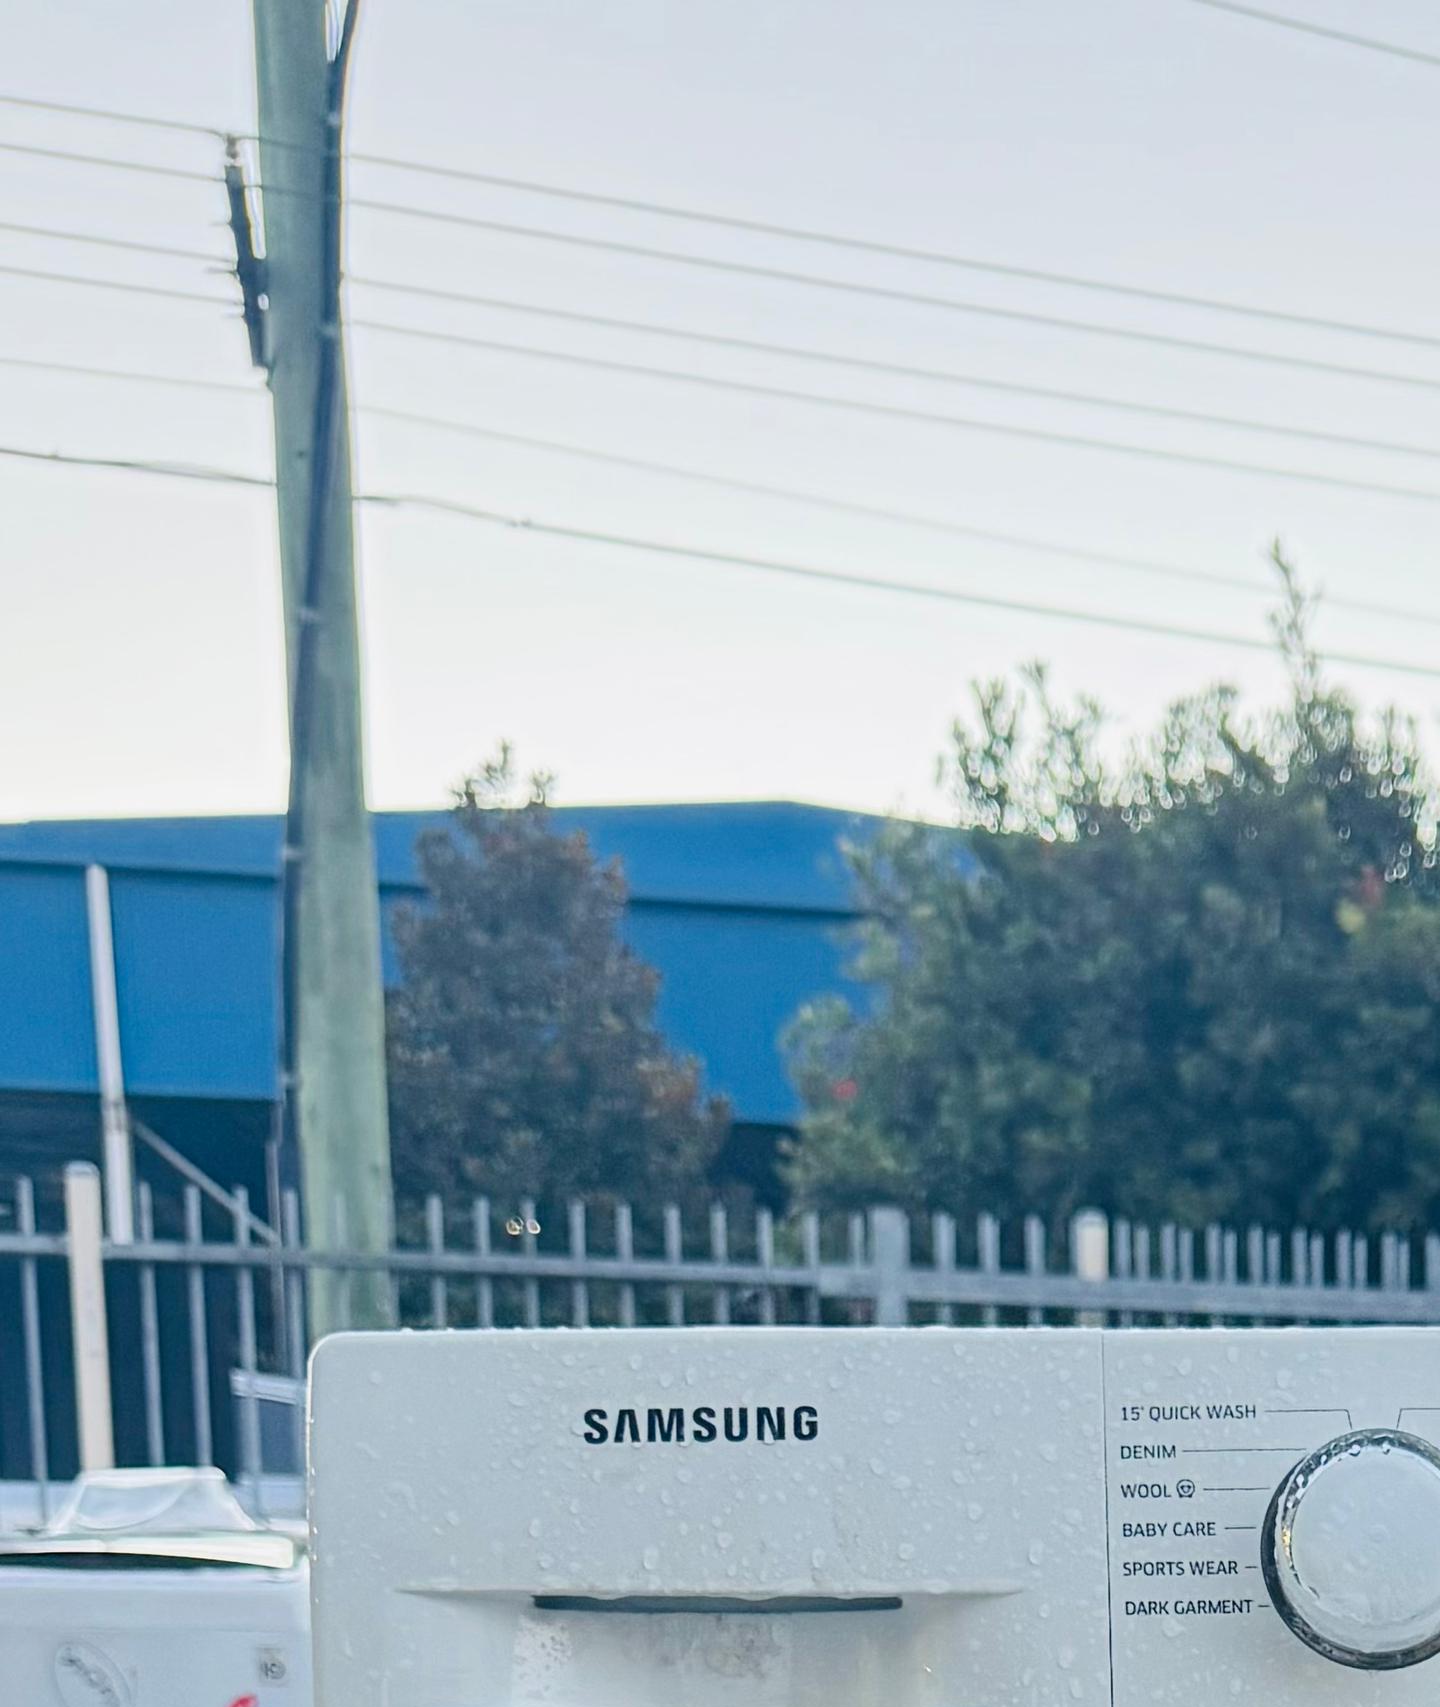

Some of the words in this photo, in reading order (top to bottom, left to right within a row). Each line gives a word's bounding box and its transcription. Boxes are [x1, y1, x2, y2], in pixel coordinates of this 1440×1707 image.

[1150, 1405, 1201, 1422] QUICK
[1206, 1404, 1256, 1419] WASH
[583, 1406, 818, 1444] SAMSUNG
[1120, 1445, 1177, 1459] DENIM
[1121, 1483, 1172, 1499] WOOL
[1122, 1523, 1168, 1538] BABY
[1173, 1522, 1216, 1537] CARE
[1122, 1561, 1185, 1577] SPORTS
[1190, 1560, 1239, 1576] WEAR
[1125, 1600, 1169, 1616] DARK
[1174, 1599, 1254, 1615] GARMENT
